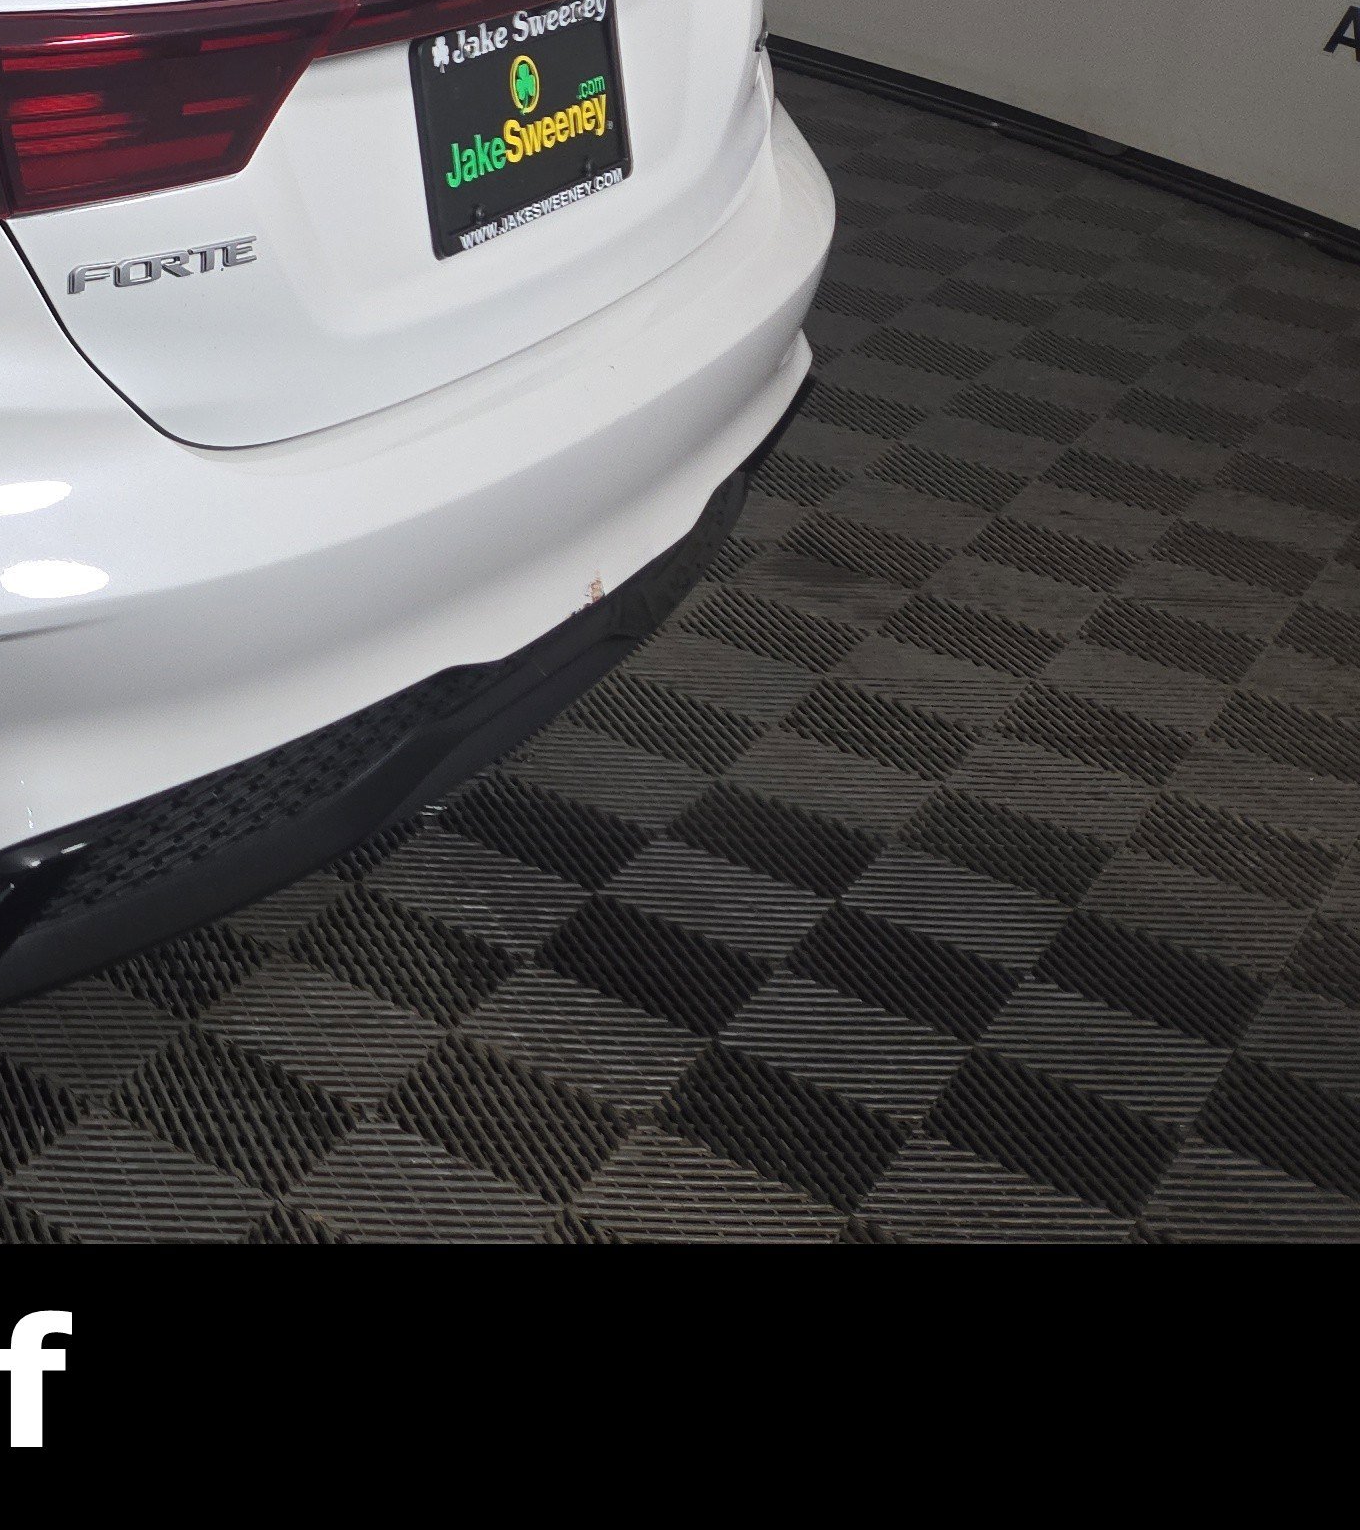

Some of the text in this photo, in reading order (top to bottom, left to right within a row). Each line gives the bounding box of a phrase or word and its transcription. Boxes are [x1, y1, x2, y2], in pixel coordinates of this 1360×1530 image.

[451, 22, 509, 64] Jake
[445, 92, 608, 189] JakeSweeney
[459, 166, 624, 250] WWW.JAKESWEENEY.COM
[66, 235, 258, 295] FORTE
